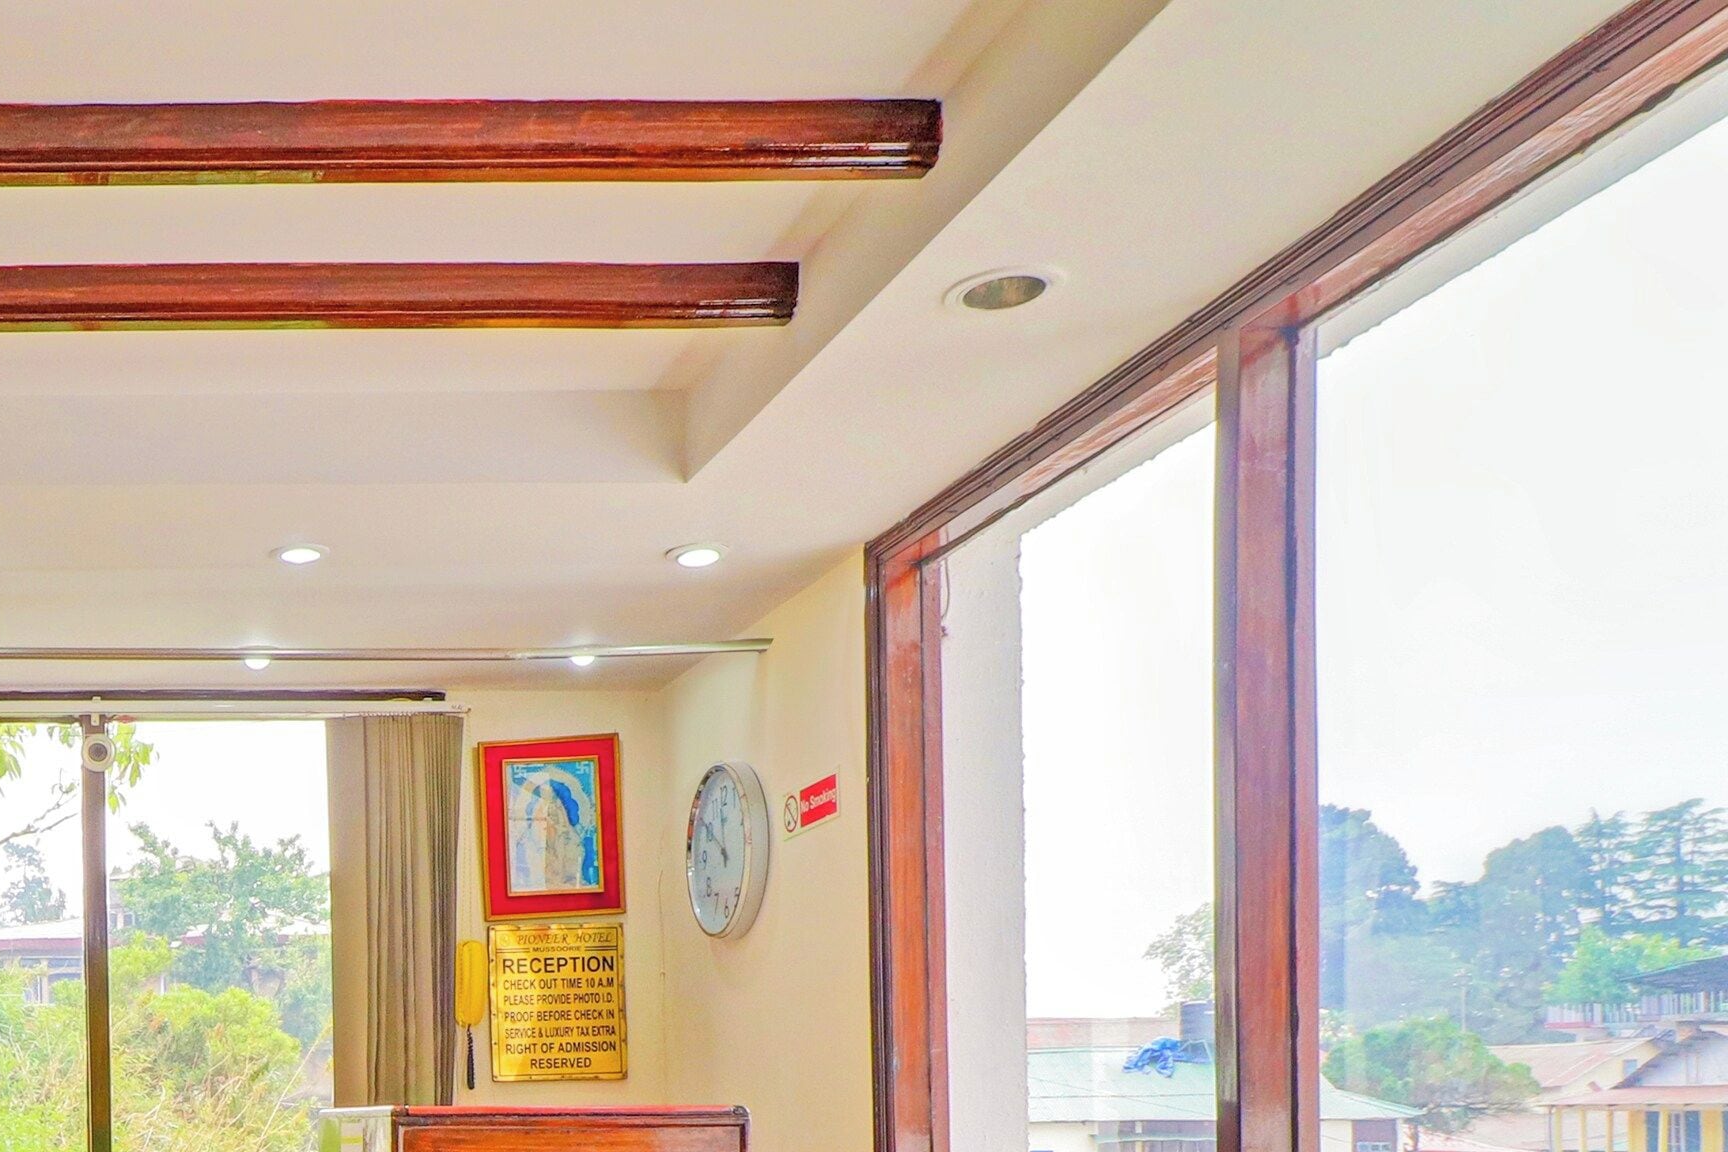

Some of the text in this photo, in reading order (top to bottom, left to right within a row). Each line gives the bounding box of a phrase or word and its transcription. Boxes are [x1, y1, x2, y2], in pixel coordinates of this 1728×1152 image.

[800, 788, 837, 813] No Smoking
[517, 931, 613, 945] PIONEER HOTEL
[502, 956, 614, 974] RECEPTION
[503, 977, 615, 991] CHECK OUT TIME 10 A.M
[503, 995, 535, 1006] PLEASE
[537, 993, 571, 1005] PROVIDE
[573, 992, 600, 1004] PHOTO
[504, 1009, 615, 1022] PROOF BEFORE CHECK IN
[505, 1025, 616, 1039] SERVICE & LUXURY TAX EXTRA
[505, 1040, 617, 1055] RIGHT OF ADMISSION
[530, 1057, 592, 1070] RESERVED
